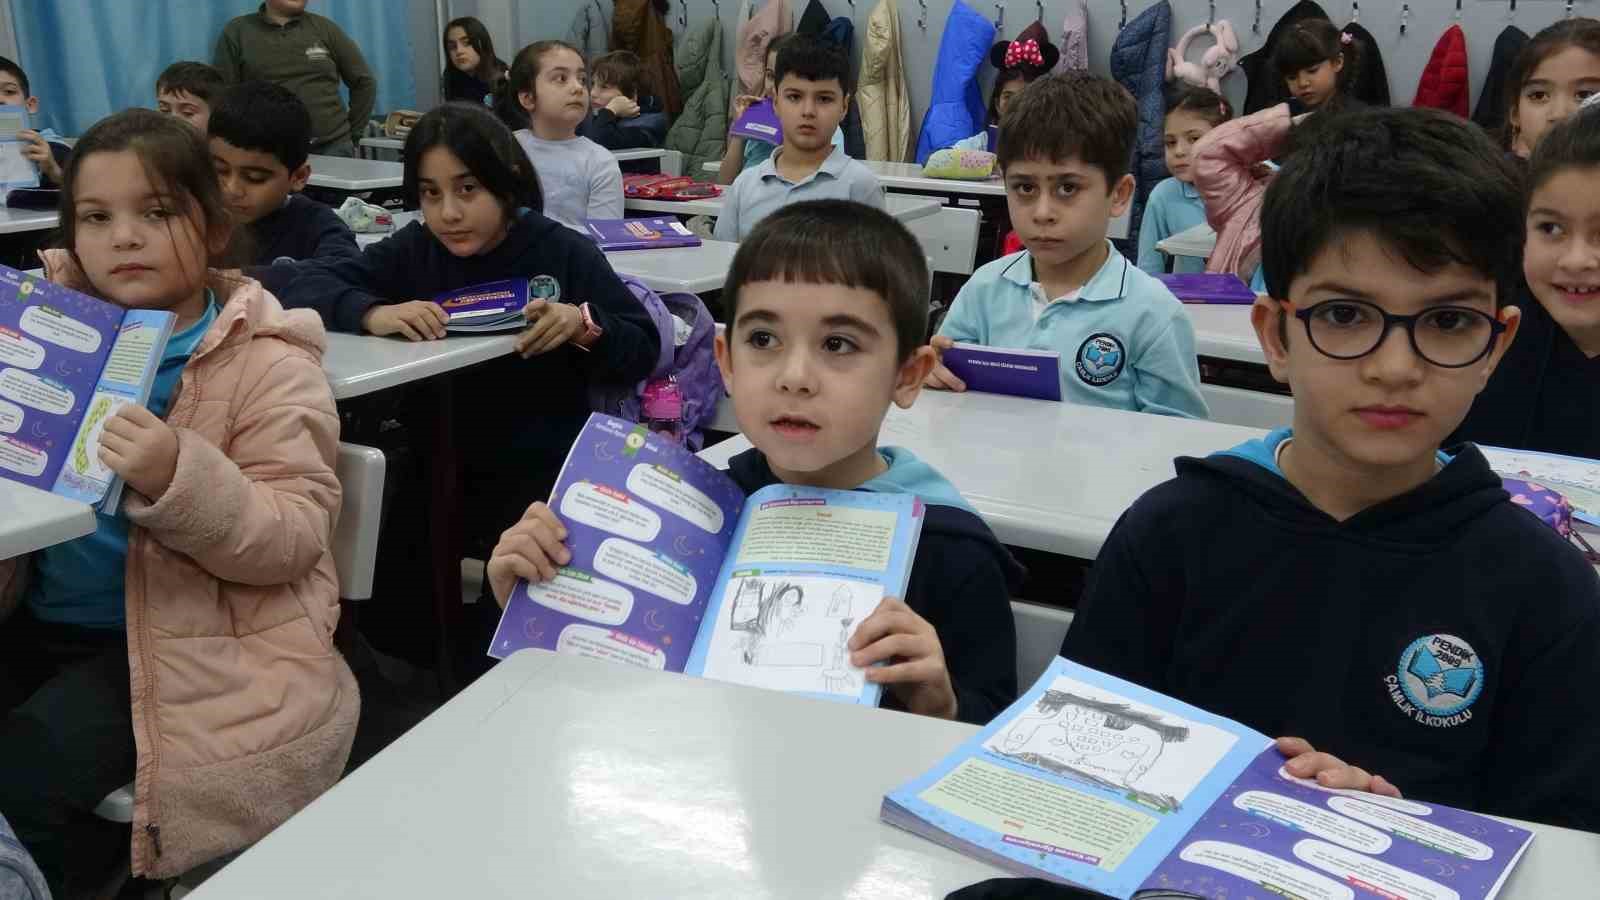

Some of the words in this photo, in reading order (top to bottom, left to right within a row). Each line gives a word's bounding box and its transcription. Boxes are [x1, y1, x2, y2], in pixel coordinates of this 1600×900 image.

[1432, 636, 1474, 663] PENDİK
[1384, 674, 1416, 717] ÇAMLIK
[1415, 708, 1473, 728] İLKOKULU
